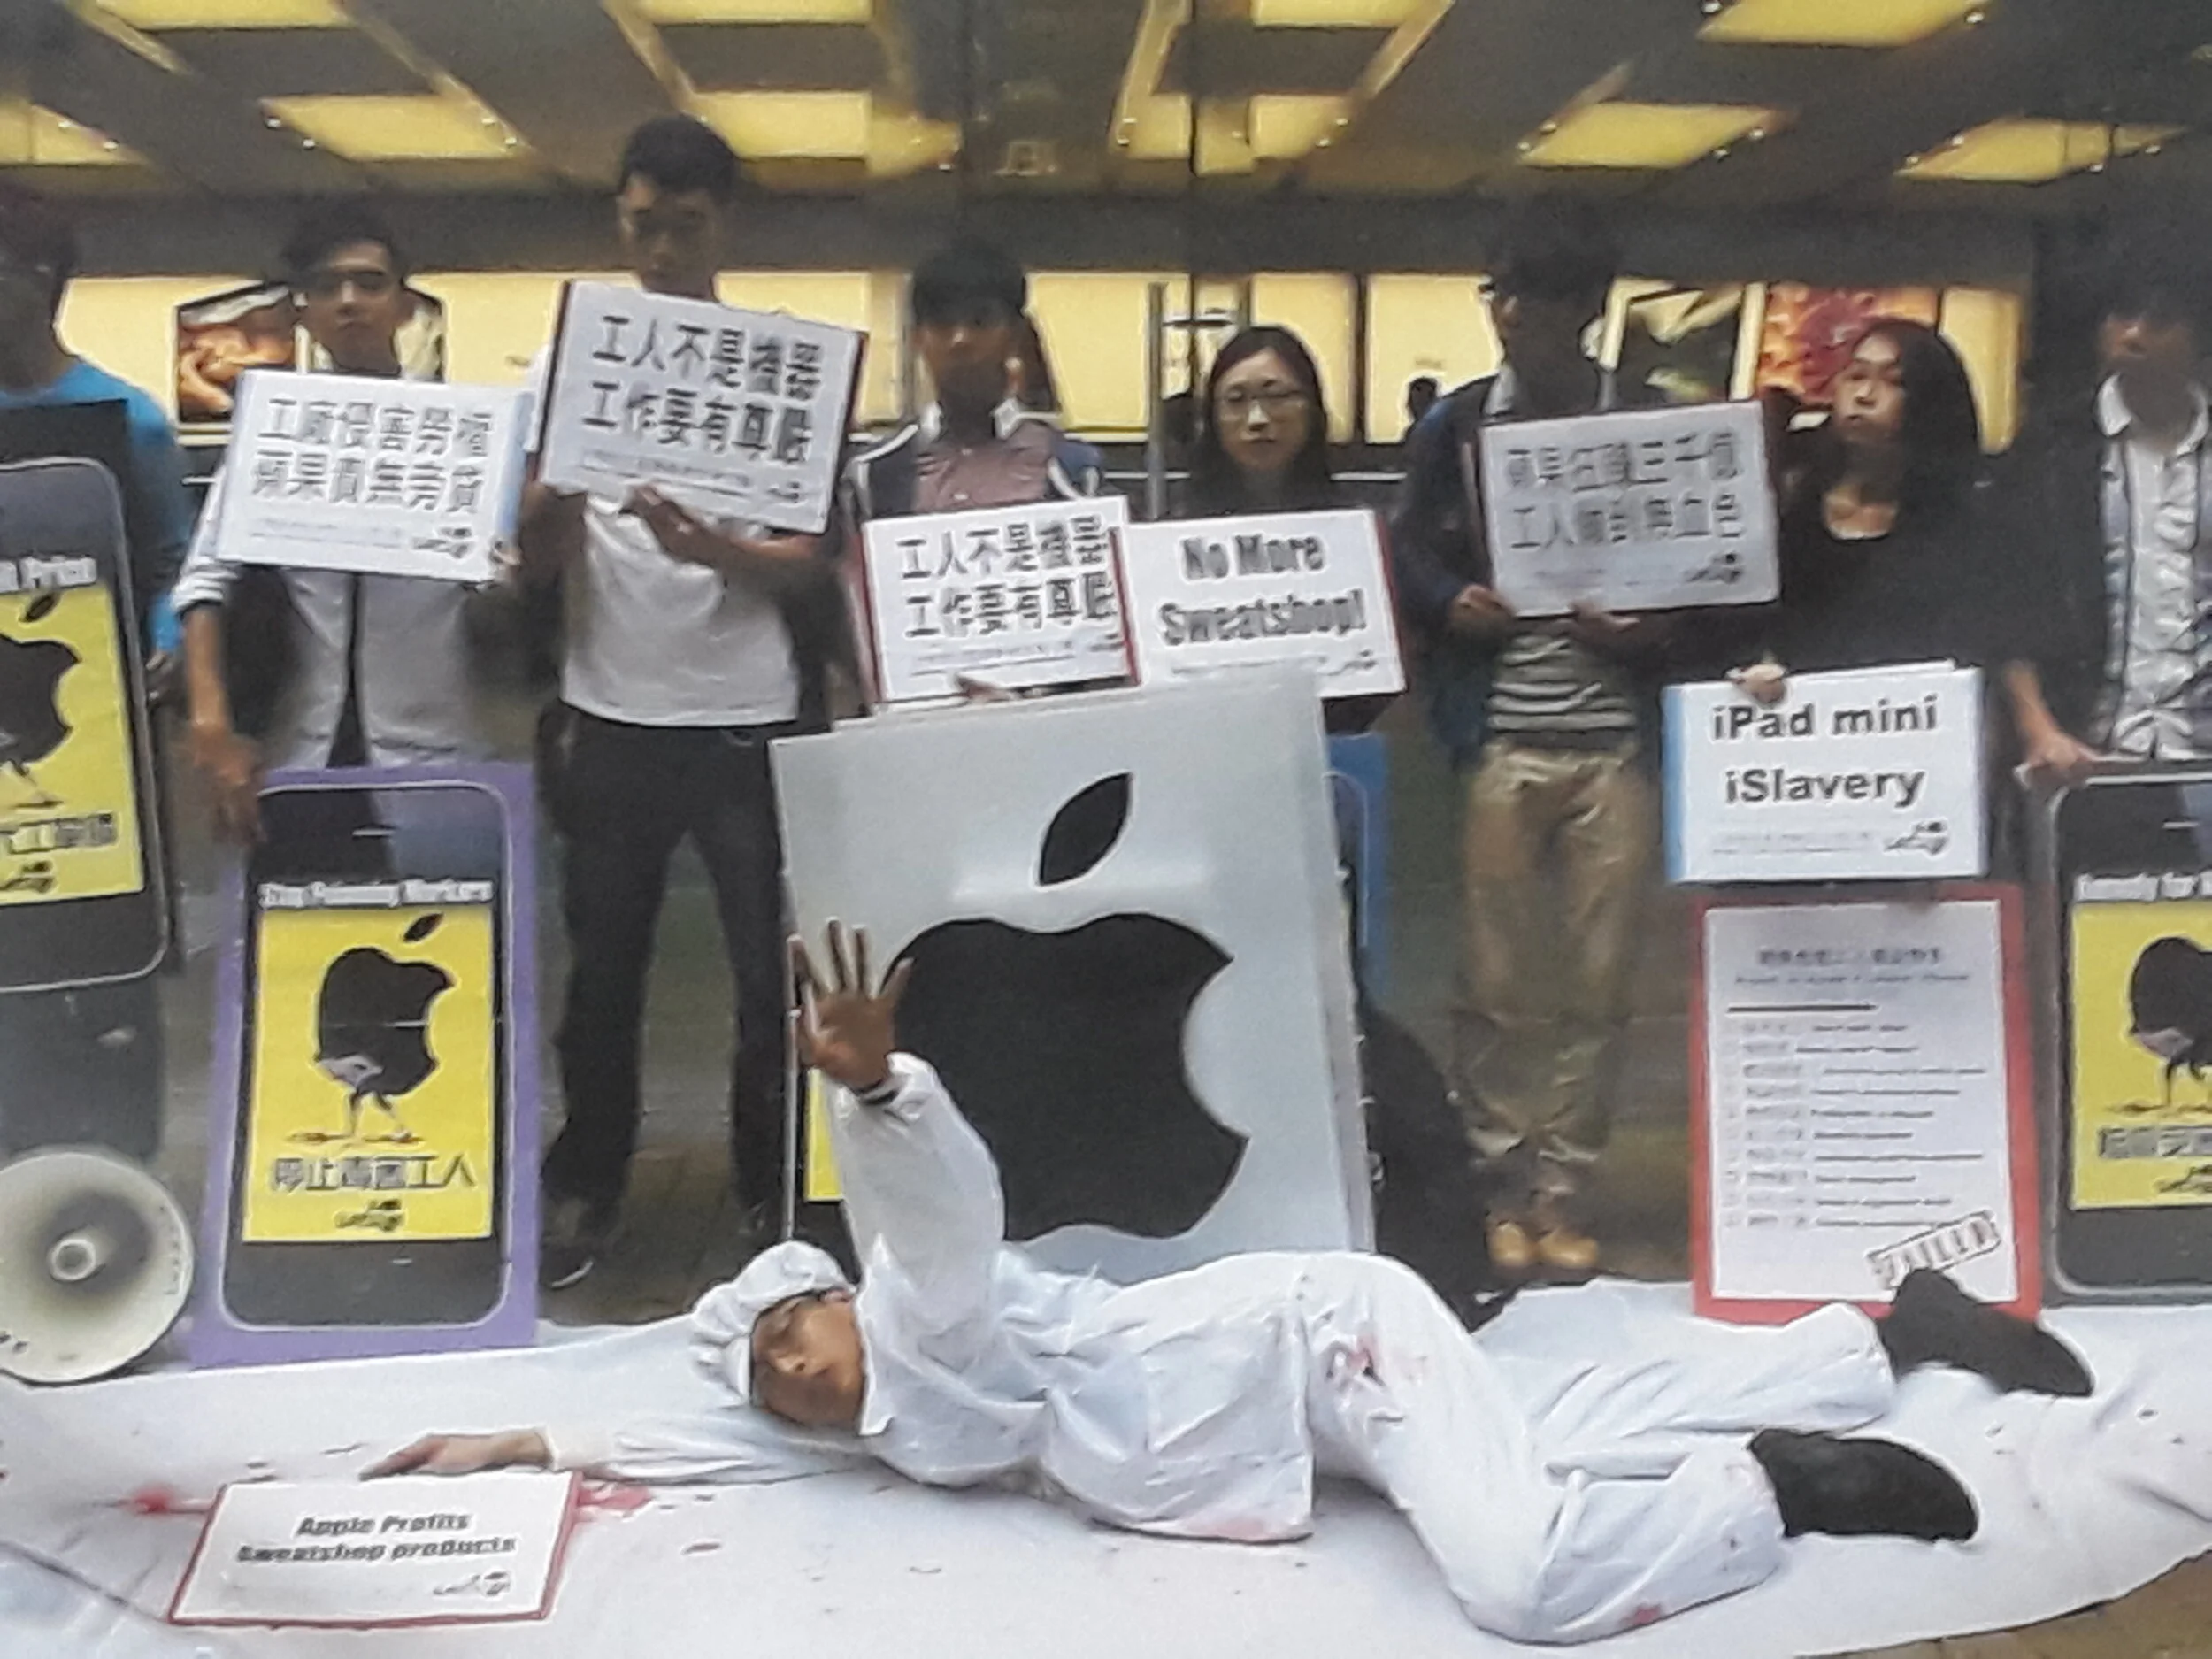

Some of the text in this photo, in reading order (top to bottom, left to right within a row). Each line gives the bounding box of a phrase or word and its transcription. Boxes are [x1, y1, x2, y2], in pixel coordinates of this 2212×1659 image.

[1180, 533, 1325, 580] No More
[1711, 692, 1939, 741] iPad mini
[1724, 768, 1927, 808] iSlavery
[296, 1515, 375, 1537] Apple
